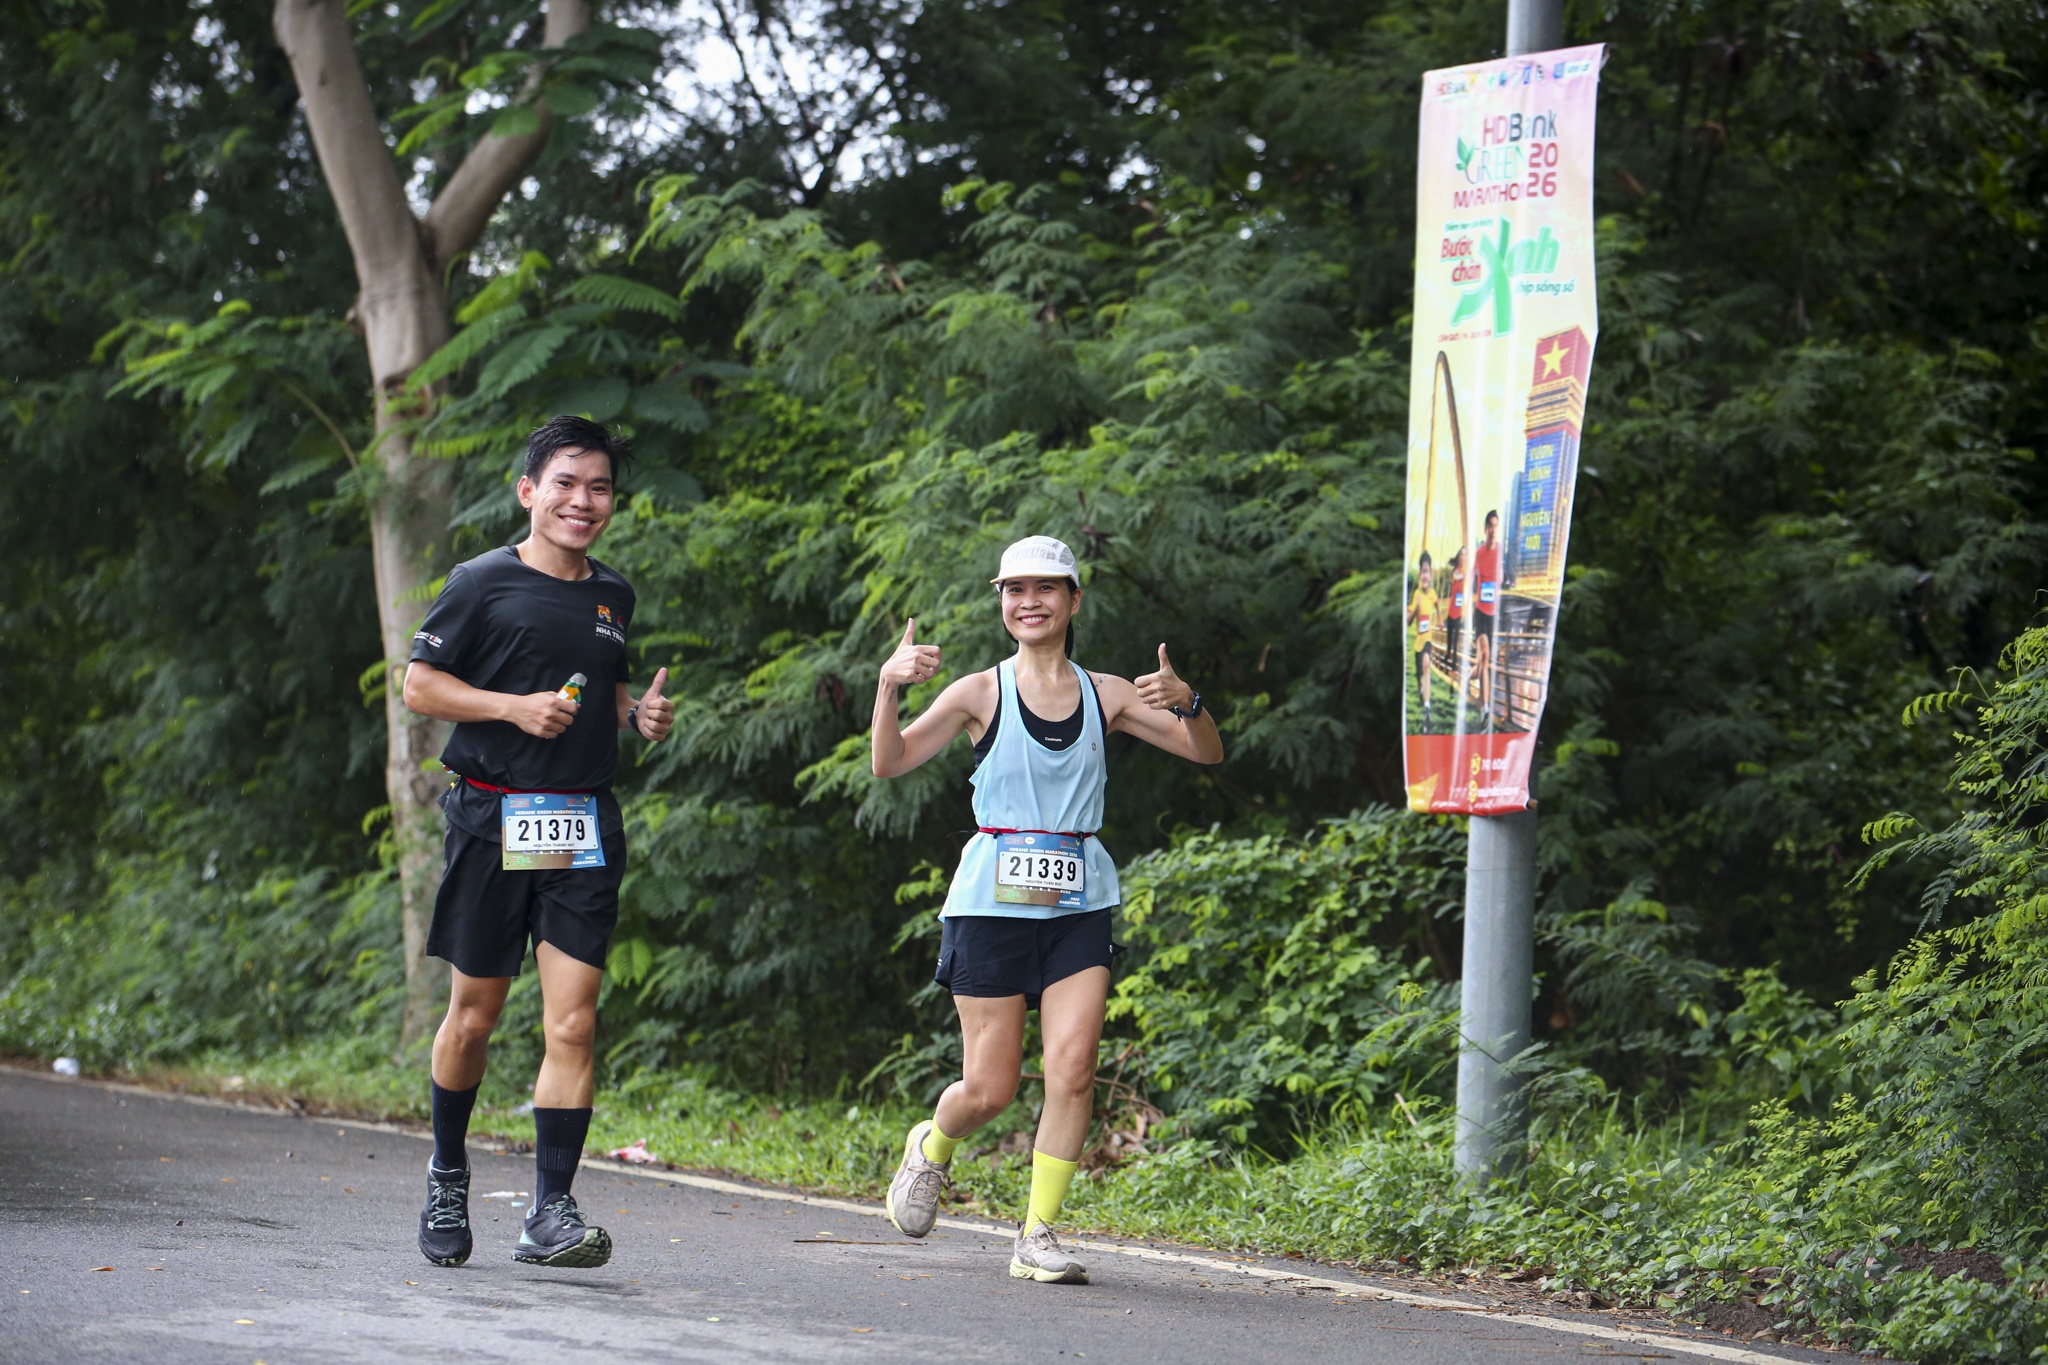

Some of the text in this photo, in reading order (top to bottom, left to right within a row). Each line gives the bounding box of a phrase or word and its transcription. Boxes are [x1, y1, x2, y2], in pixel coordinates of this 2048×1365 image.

[1482, 109, 1558, 147] HDBank
[1528, 142, 1559, 168] 20
[1527, 172, 1557, 198] 26
[1441, 235, 1473, 259] Bước
[596, 626, 612, 636] NHA
[518, 819, 586, 841] 21379
[1045, 849, 1069, 857] MARATHON
[1009, 856, 1076, 882] 21339
